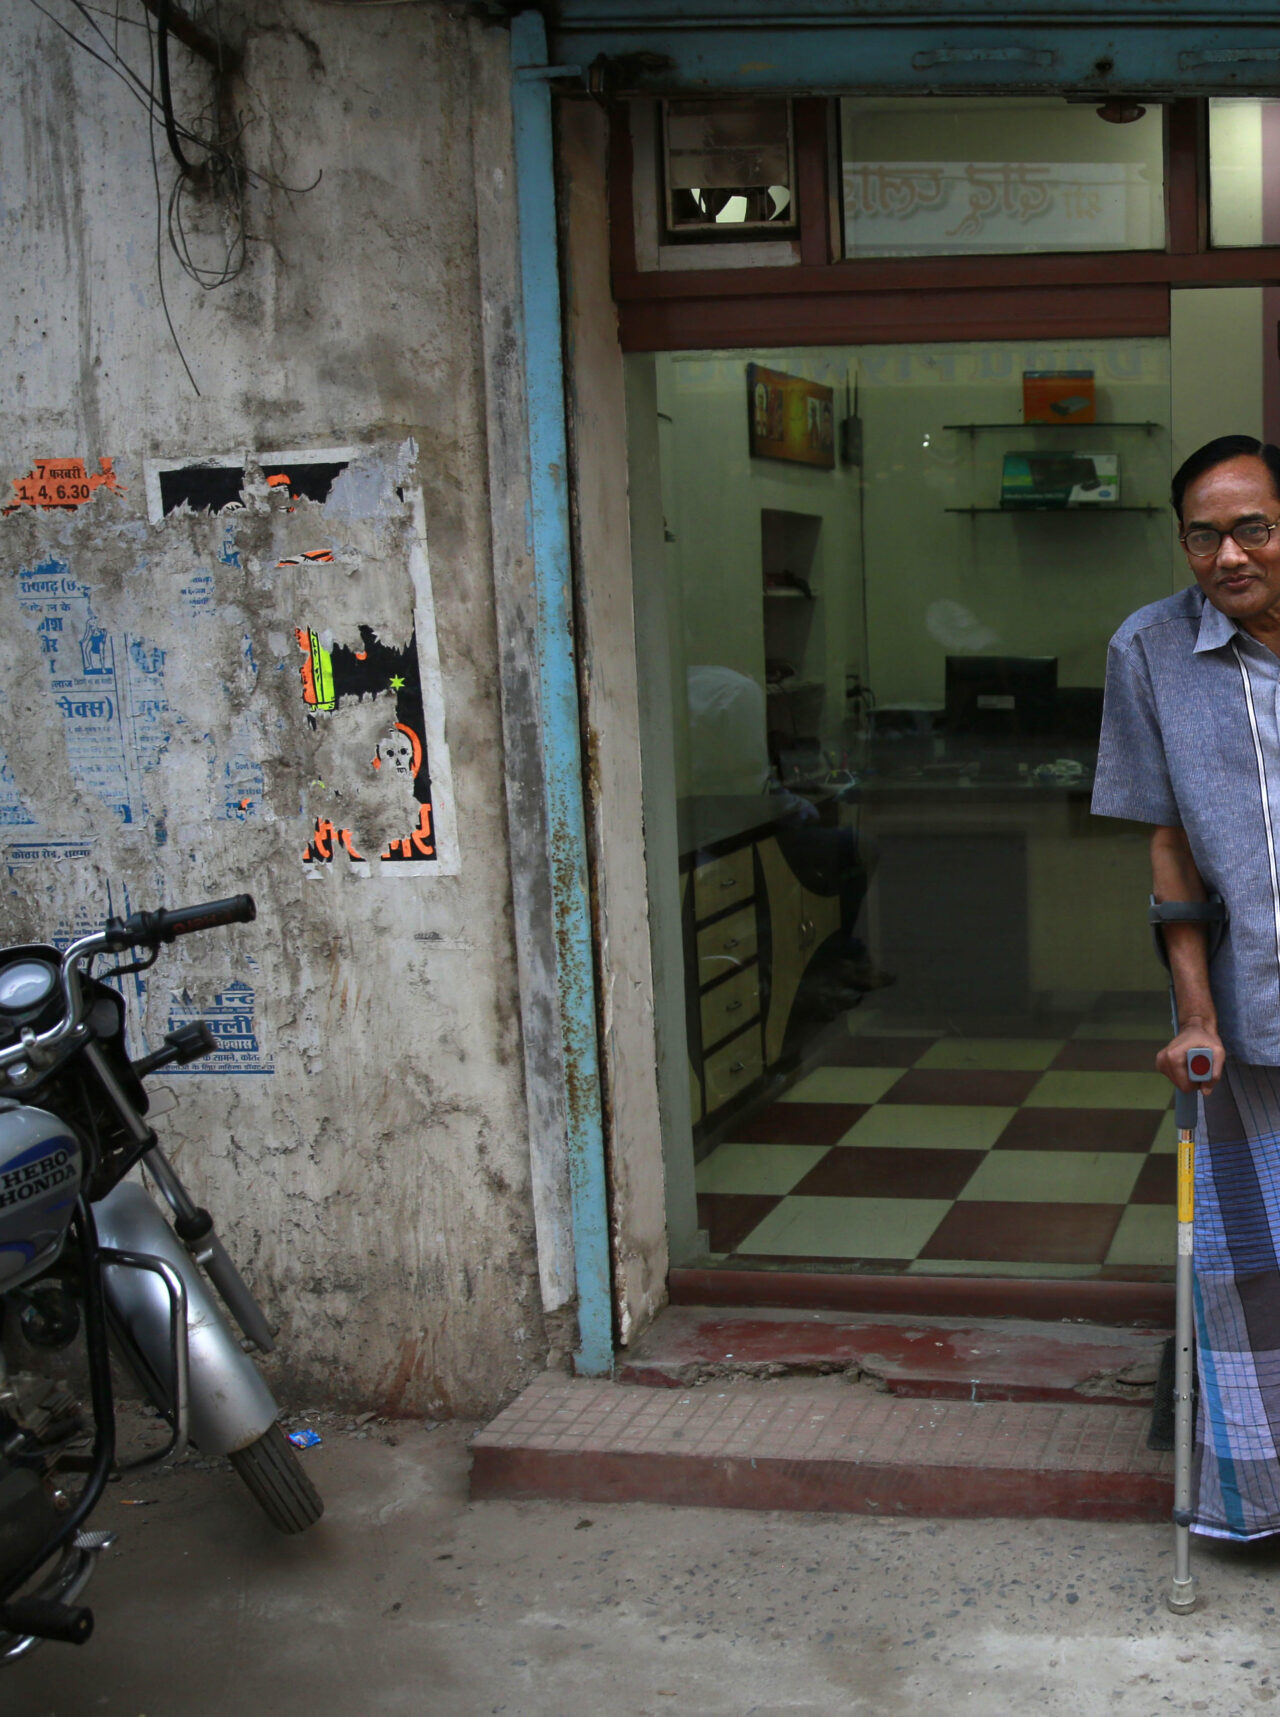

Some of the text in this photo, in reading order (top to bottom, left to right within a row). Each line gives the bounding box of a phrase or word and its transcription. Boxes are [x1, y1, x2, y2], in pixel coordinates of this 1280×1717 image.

[56, 484, 90, 500] 6.30
[0, 1164, 77, 1208] HONDA
[1, 1150, 68, 1190] HERO
